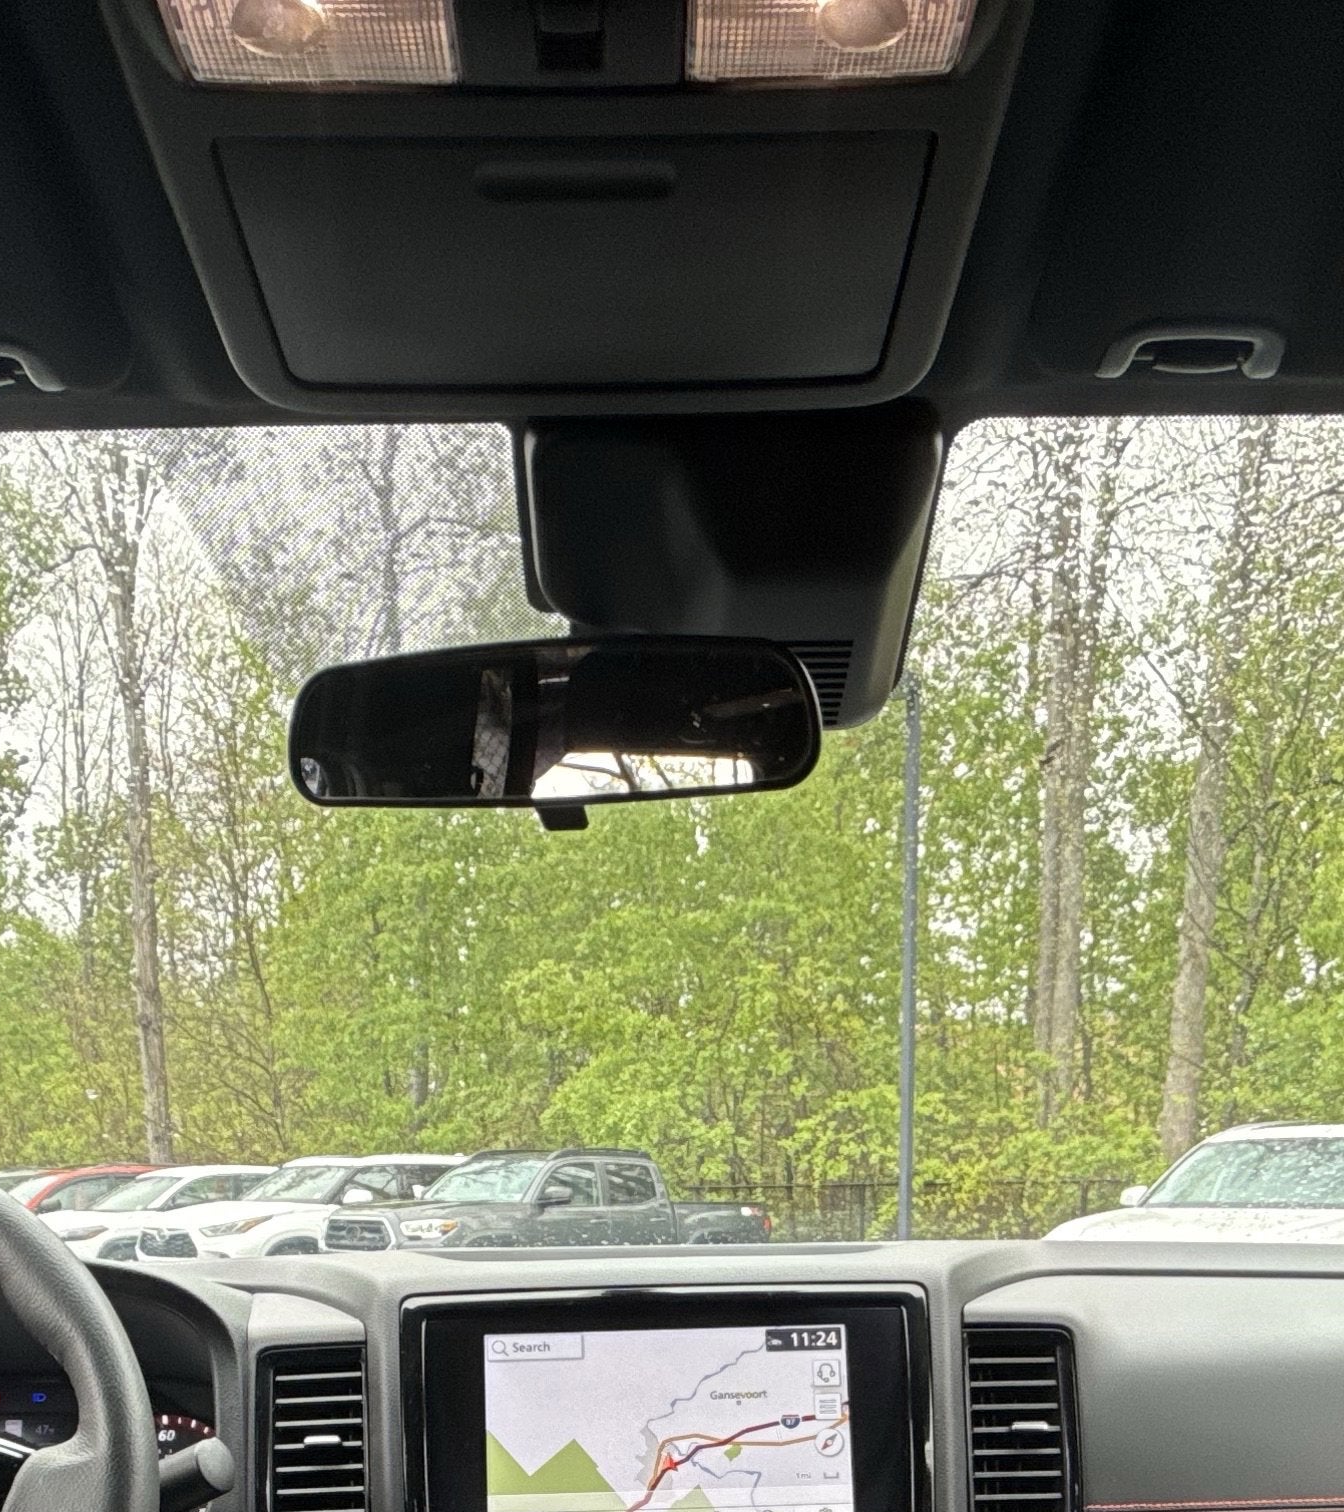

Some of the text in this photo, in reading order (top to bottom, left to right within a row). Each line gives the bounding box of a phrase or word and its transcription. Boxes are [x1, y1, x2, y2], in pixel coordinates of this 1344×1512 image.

[789, 1330, 838, 1348] 11:24
[512, 1341, 551, 1354] Search
[709, 1389, 768, 1401] Gansevoort
[158, 1429, 175, 1441] 60
